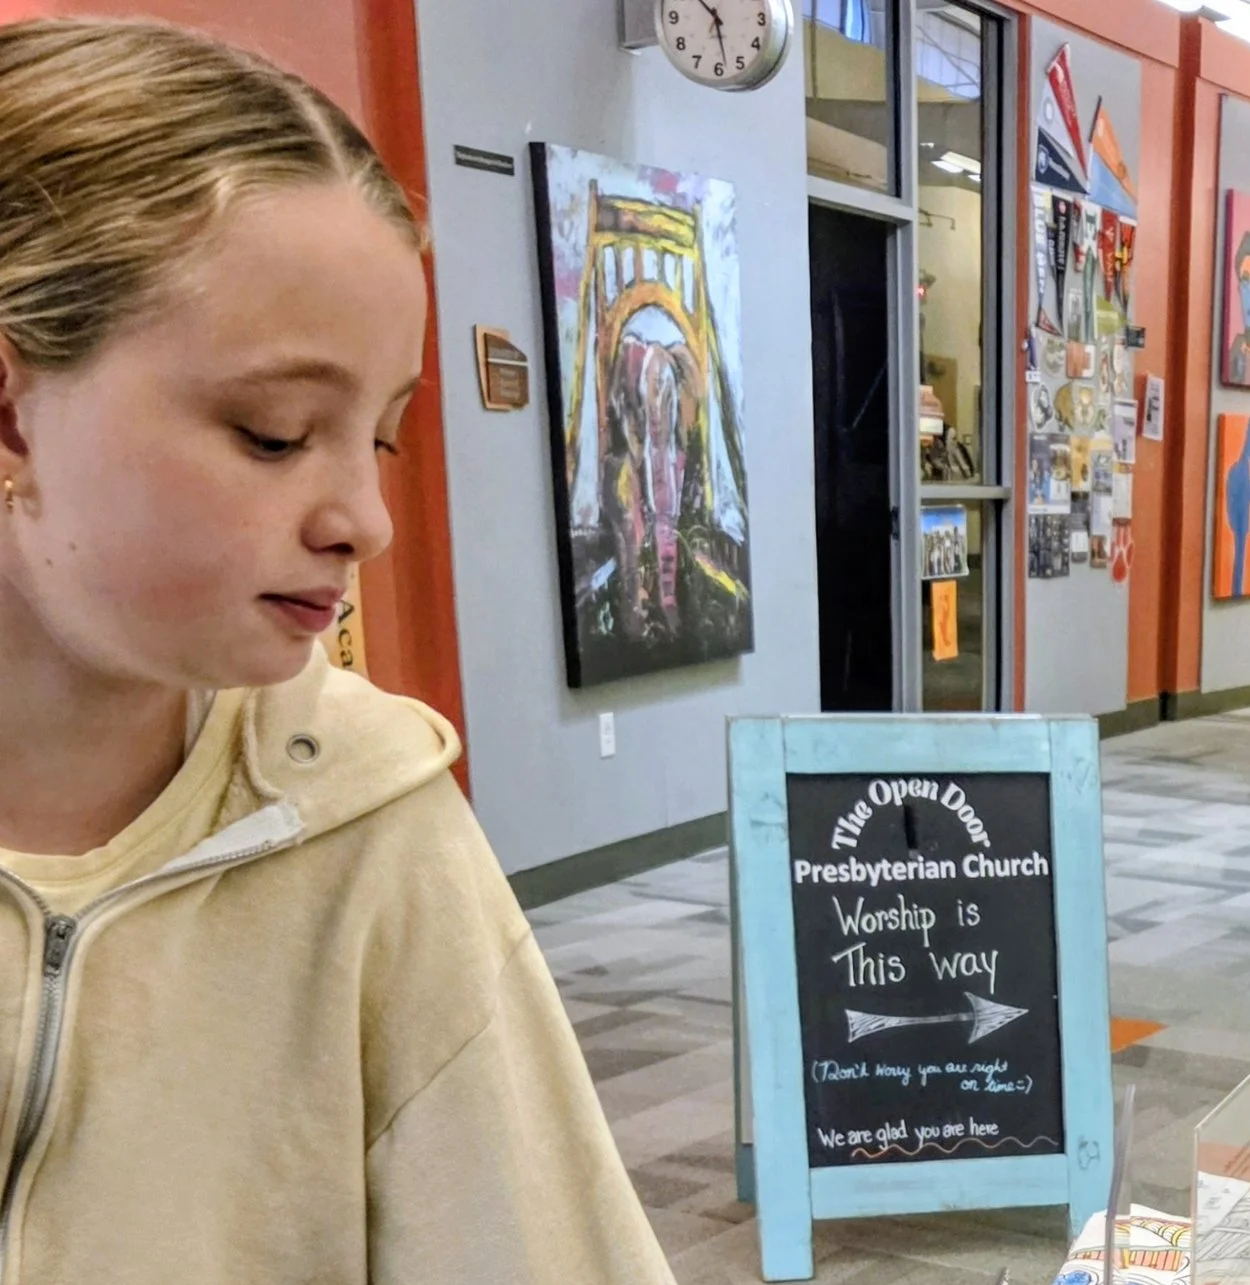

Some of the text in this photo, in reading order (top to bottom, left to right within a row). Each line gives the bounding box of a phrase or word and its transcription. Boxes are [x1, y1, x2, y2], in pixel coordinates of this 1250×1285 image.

[669, 10, 678, 25] 9
[757, 12, 766, 26] 3
[676, 36, 686, 51] 8
[751, 36, 761, 51] 4
[692, 55, 702, 69] 7
[714, 62, 724, 77] 6
[736, 56, 745, 70] 5
[831, 777, 991, 850] The Open Door
[794, 852, 1049, 887] Presbyterian Church
[832, 893, 981, 948] Worship is
[831, 942, 999, 995] This way
[918, 1063, 941, 1087] you
[946, 1062, 968, 1073] are
[969, 1058, 1008, 1082] right
[960, 1079, 979, 1090] on
[817, 1116, 999, 1150] We are glad you are here
